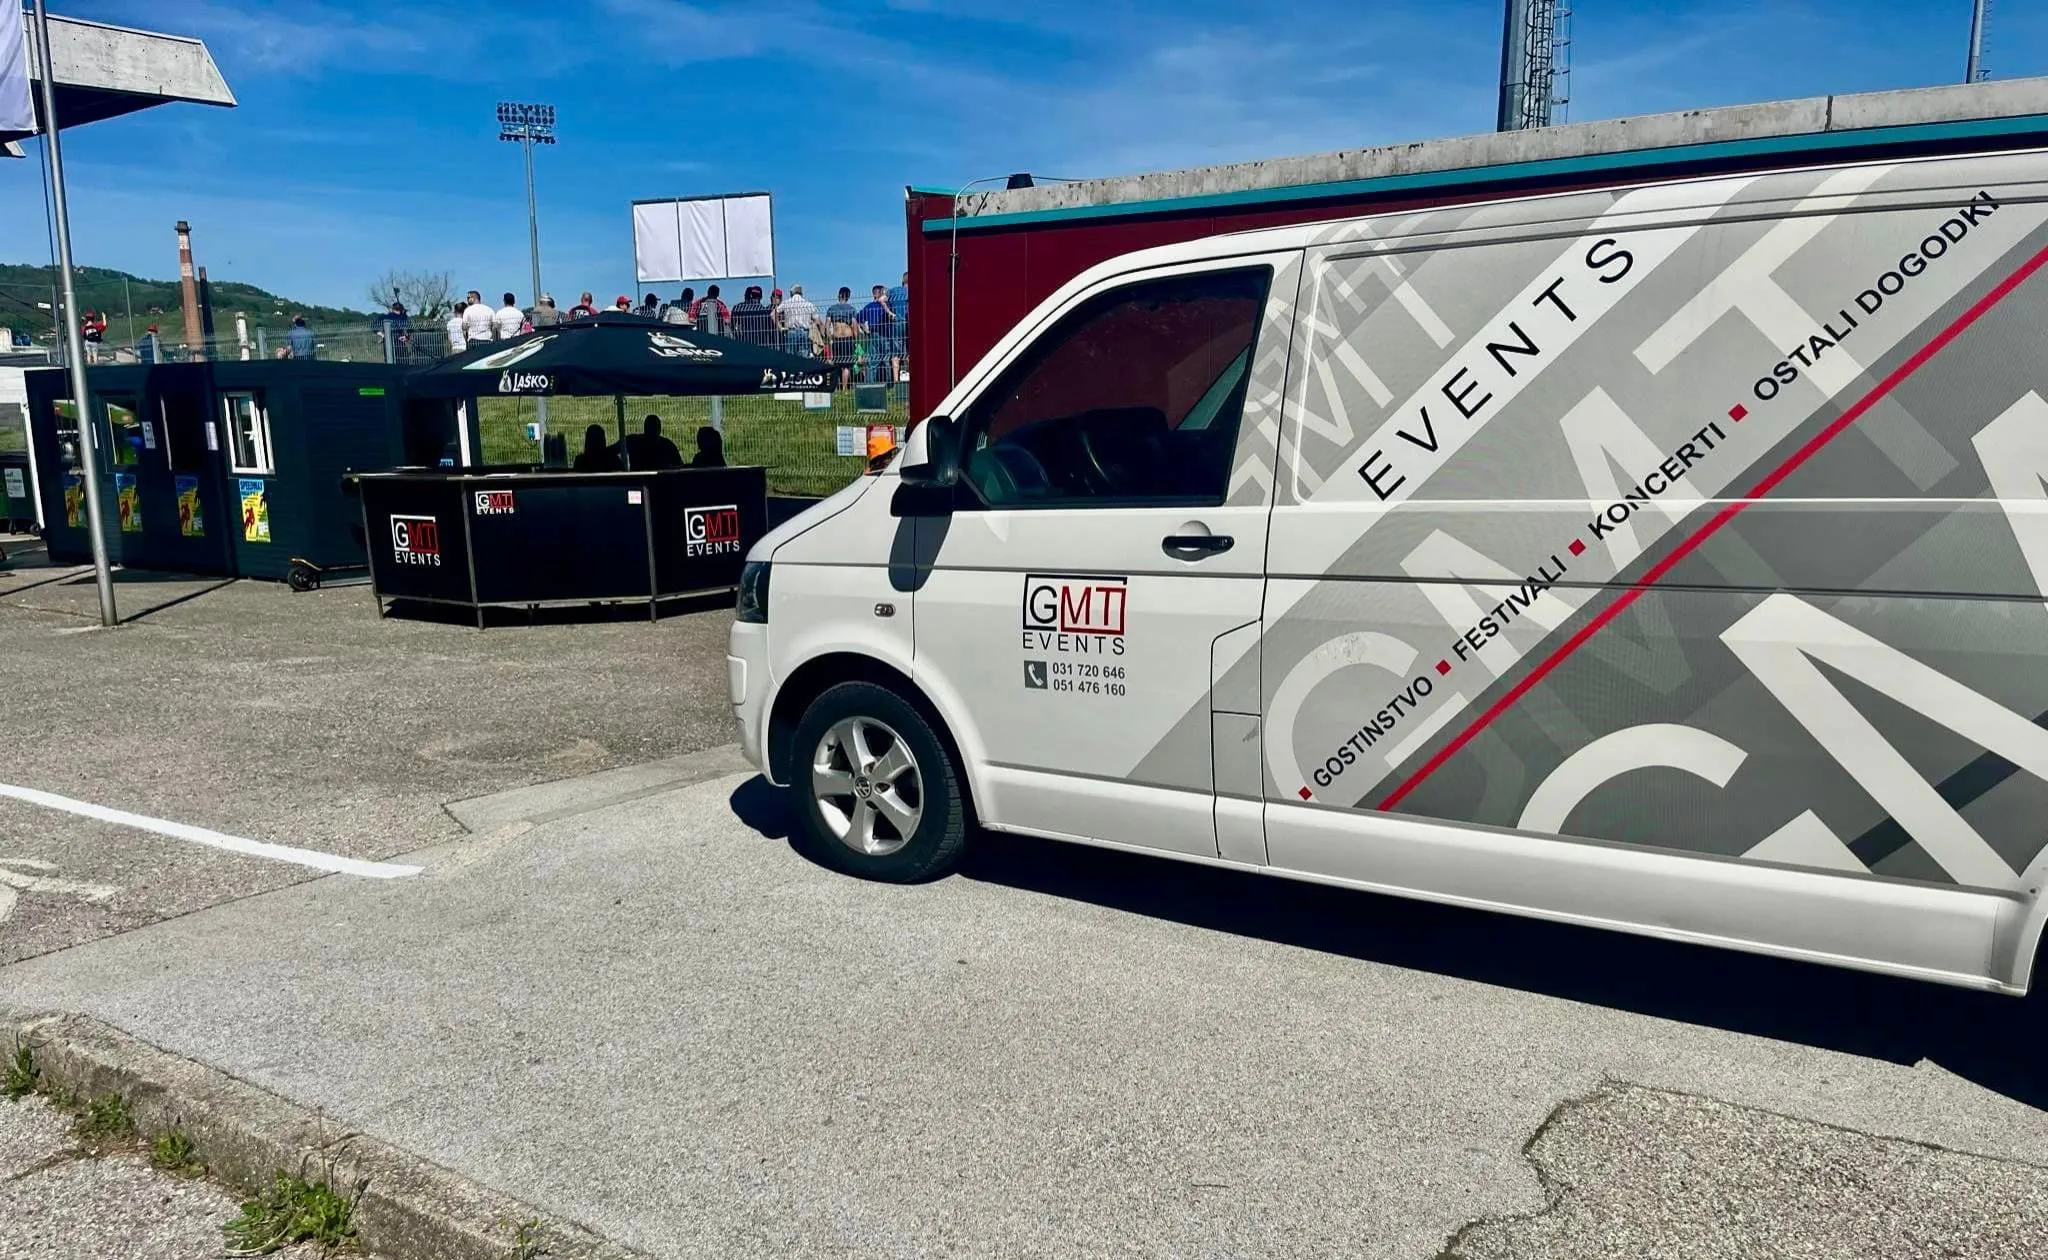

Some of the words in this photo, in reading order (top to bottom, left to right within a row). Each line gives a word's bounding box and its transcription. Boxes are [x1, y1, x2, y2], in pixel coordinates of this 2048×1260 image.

[1753, 309, 1859, 402] OSTALI
[1854, 190, 2001, 315] DOGODKI
[1358, 238, 1634, 501] EVENTS
[1587, 421, 1727, 540] KONCERTI
[476, 507, 515, 515] EVENTS
[478, 493, 514, 508] GMT
[394, 520, 438, 549] GMT
[689, 510, 739, 541] GMT
[394, 551, 441, 567] EVENTS
[687, 540, 740, 556] EVENTS
[1028, 583, 1127, 628] GMT
[1452, 555, 1568, 662] FESTIVALI
[1023, 632, 1125, 655] EVENTS
[1052, 662, 1073, 675] 031
[1078, 664, 1099, 677] 720
[1103, 666, 1126, 679] 646
[1053, 679, 1074, 692] 051
[1078, 681, 1100, 694] 476
[1104, 683, 1126, 697] 160
[1313, 675, 1433, 788] GOSTINSTVO
